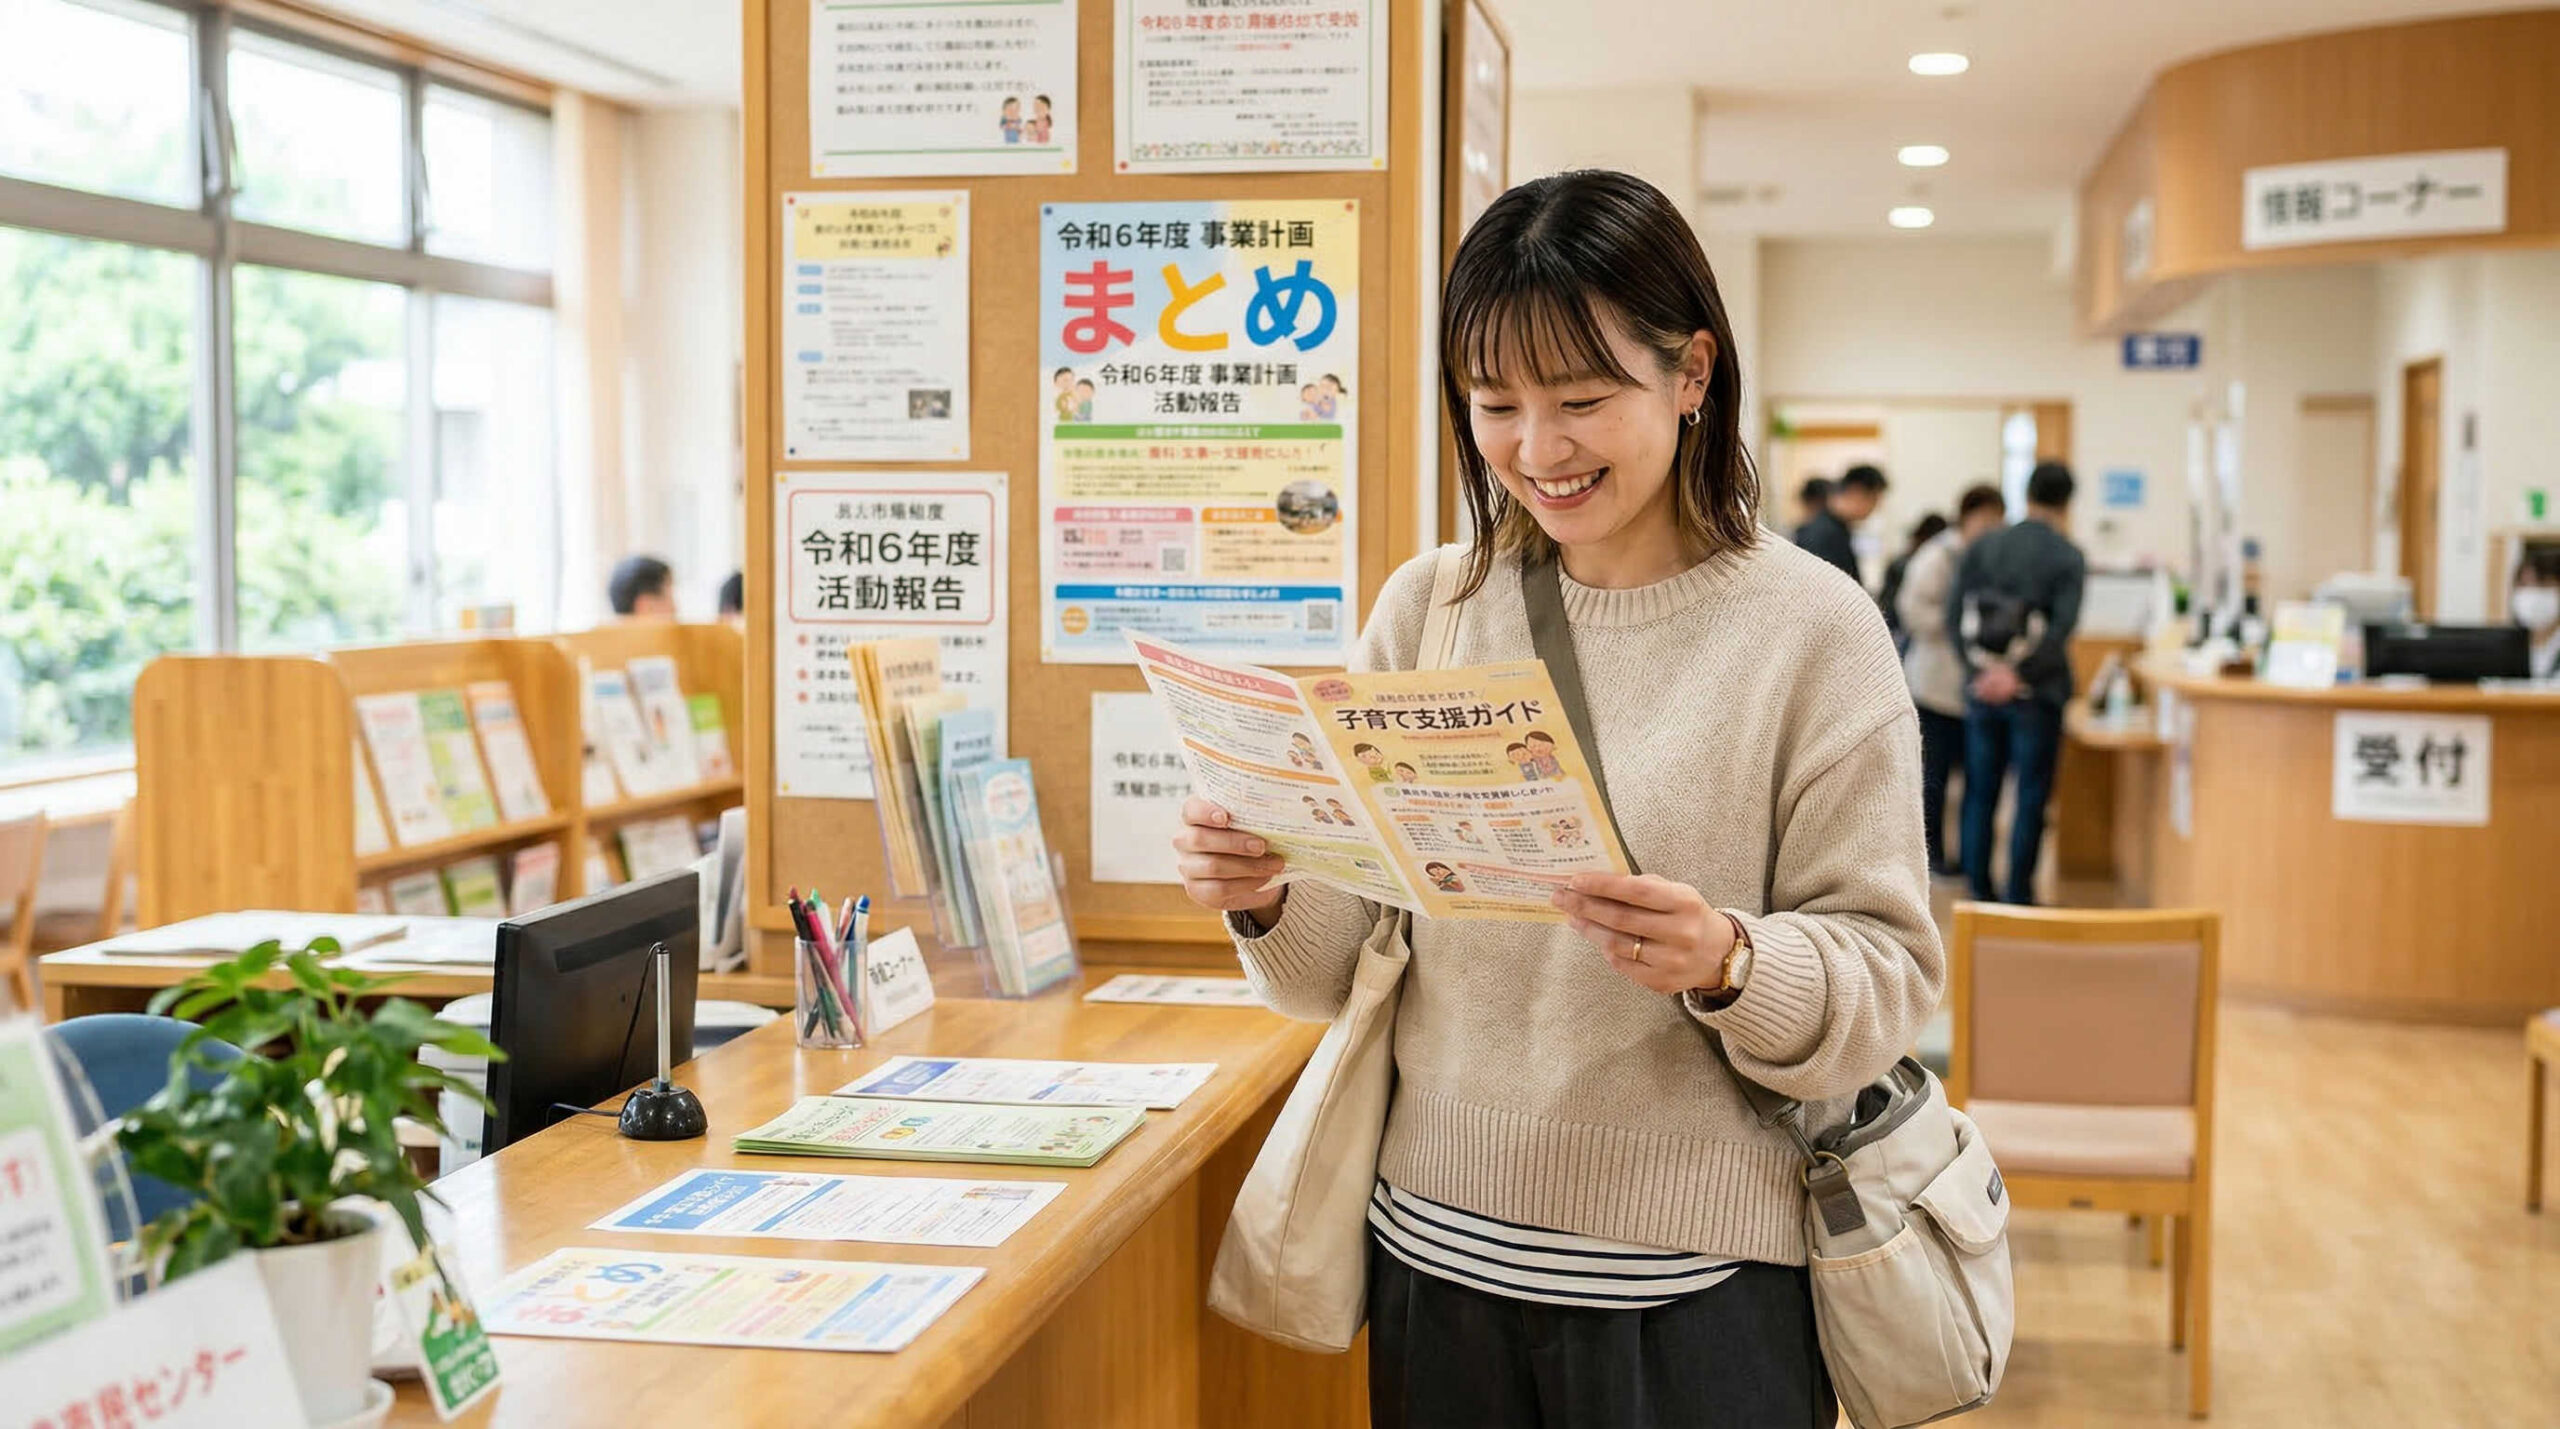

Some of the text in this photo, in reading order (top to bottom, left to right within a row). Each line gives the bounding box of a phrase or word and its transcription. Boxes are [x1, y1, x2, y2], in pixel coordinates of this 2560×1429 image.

[1057, 219, 1314, 250] 令和6年度 事業計画
[1062, 259, 1338, 355] まとめ
[1099, 362, 1298, 386] 令和6年度 事業計画
[1154, 391, 1242, 415] 活動報告
[801, 529, 981, 568] 令和6年度
[816, 575, 966, 612] 活動報告
[1334, 699, 1543, 731] 子育て支援ガイド
[2354, 733, 2468, 788] 受付
